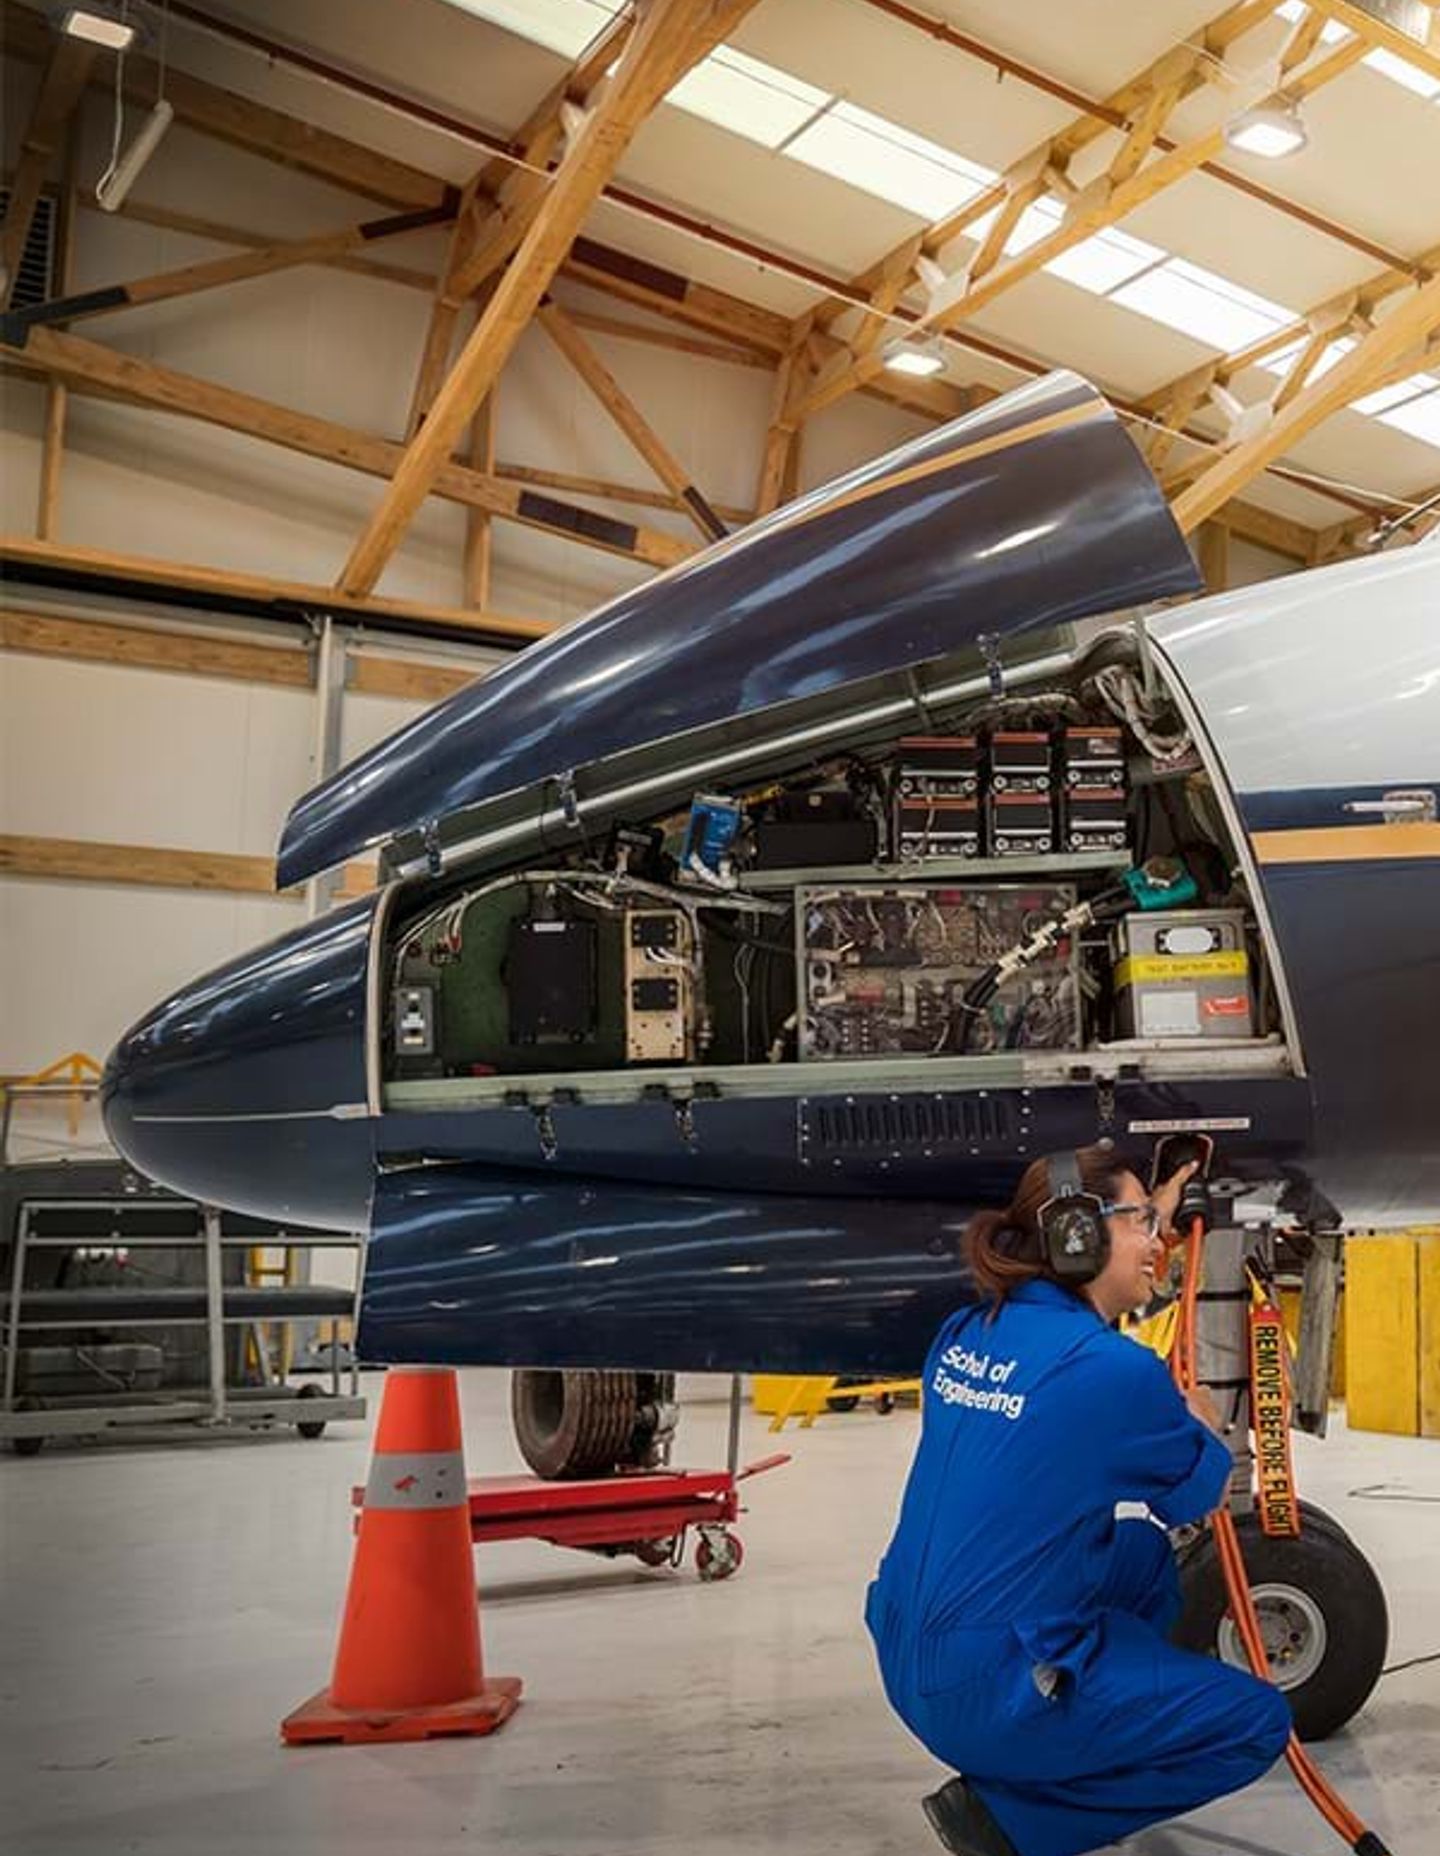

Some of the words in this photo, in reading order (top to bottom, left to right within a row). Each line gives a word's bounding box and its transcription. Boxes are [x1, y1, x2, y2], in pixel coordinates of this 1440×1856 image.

[989, 1360, 1017, 1384] of
[1255, 1326, 1284, 1401] REMOVE
[932, 1367, 1025, 1420] Engineering
[1259, 1406, 1286, 1474] BEFORE
[1264, 1479, 1293, 1536] FLIGHT
